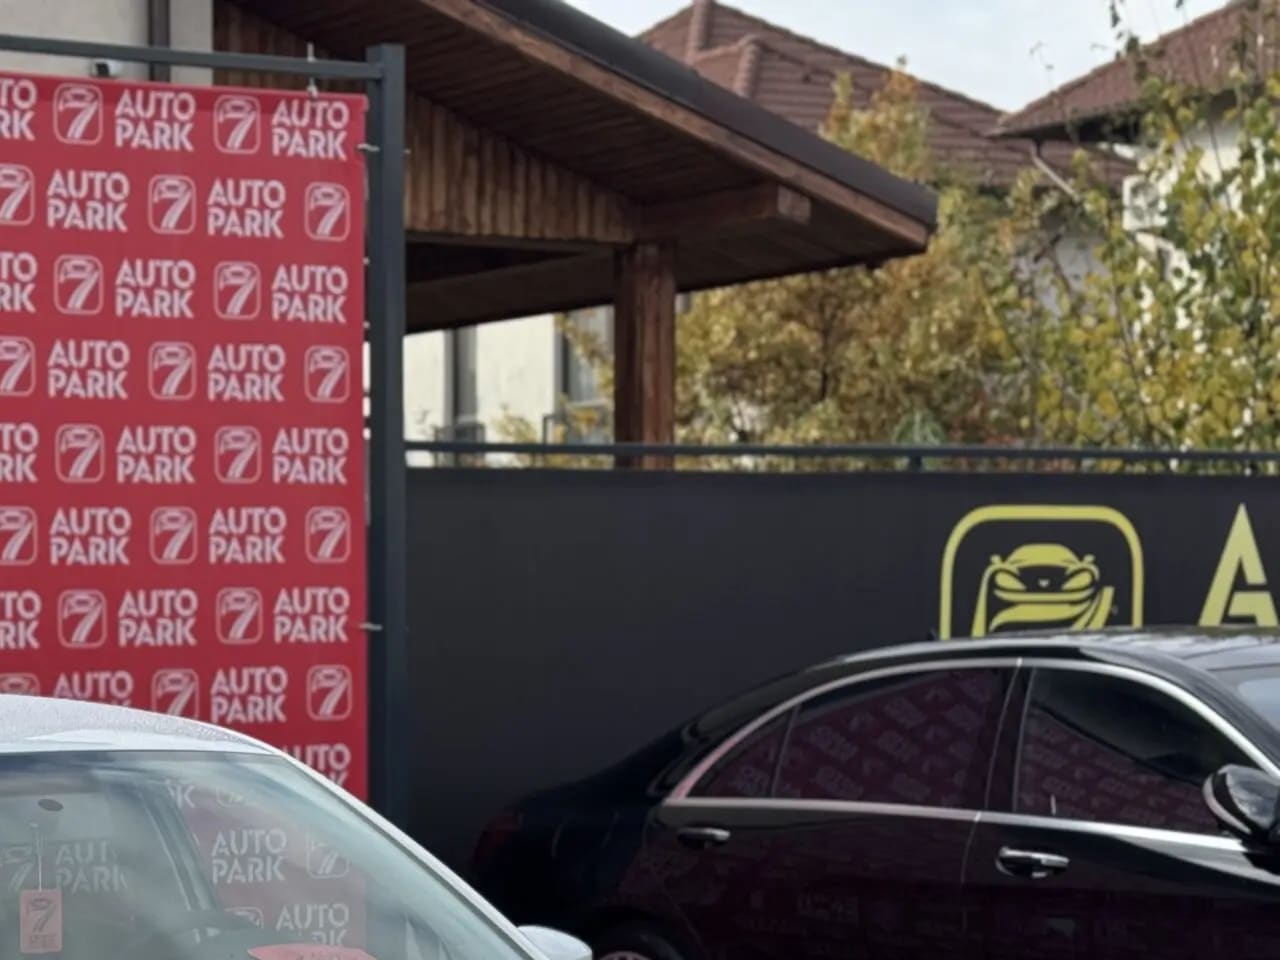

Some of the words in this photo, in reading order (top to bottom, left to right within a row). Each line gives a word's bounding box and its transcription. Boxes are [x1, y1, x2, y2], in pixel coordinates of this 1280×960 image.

[114, 91, 197, 122] AUTO
[271, 99, 350, 130] AUTO
[115, 117, 194, 152] PARK
[272, 126, 347, 161] PARK
[46, 169, 130, 203] AUTO
[207, 178, 286, 209] AUTO
[47, 197, 128, 233] PARK
[207, 206, 284, 239] PARK
[115, 258, 197, 290] AUTO
[271, 264, 349, 295] AUTO
[115, 285, 194, 319] PARK
[271, 291, 347, 324] PARK
[47, 339, 131, 371] AUTO
[207, 343, 286, 373] AUTO
[47, 367, 129, 400] PARK
[207, 371, 284, 402] PARK
[116, 425, 197, 455] AUTO
[271, 427, 349, 457] AUTO
[116, 453, 196, 484] PARK
[272, 452, 347, 485] PARK
[49, 506, 132, 537] AUTO
[208, 506, 287, 537] AUTO
[49, 535, 130, 566] PARK
[208, 533, 285, 564] PARK
[118, 588, 199, 620] AUTO
[273, 586, 350, 617] AUTO
[118, 617, 197, 647] PARK
[273, 613, 349, 643] PARK
[53, 671, 134, 700] AUTO
[210, 665, 289, 697] AUTO
[211, 695, 287, 724] PARK
[283, 743, 351, 773] UTO
[211, 828, 287, 857] AUTO
[211, 857, 287, 884] PARK
[275, 902, 350, 932] AUTO
